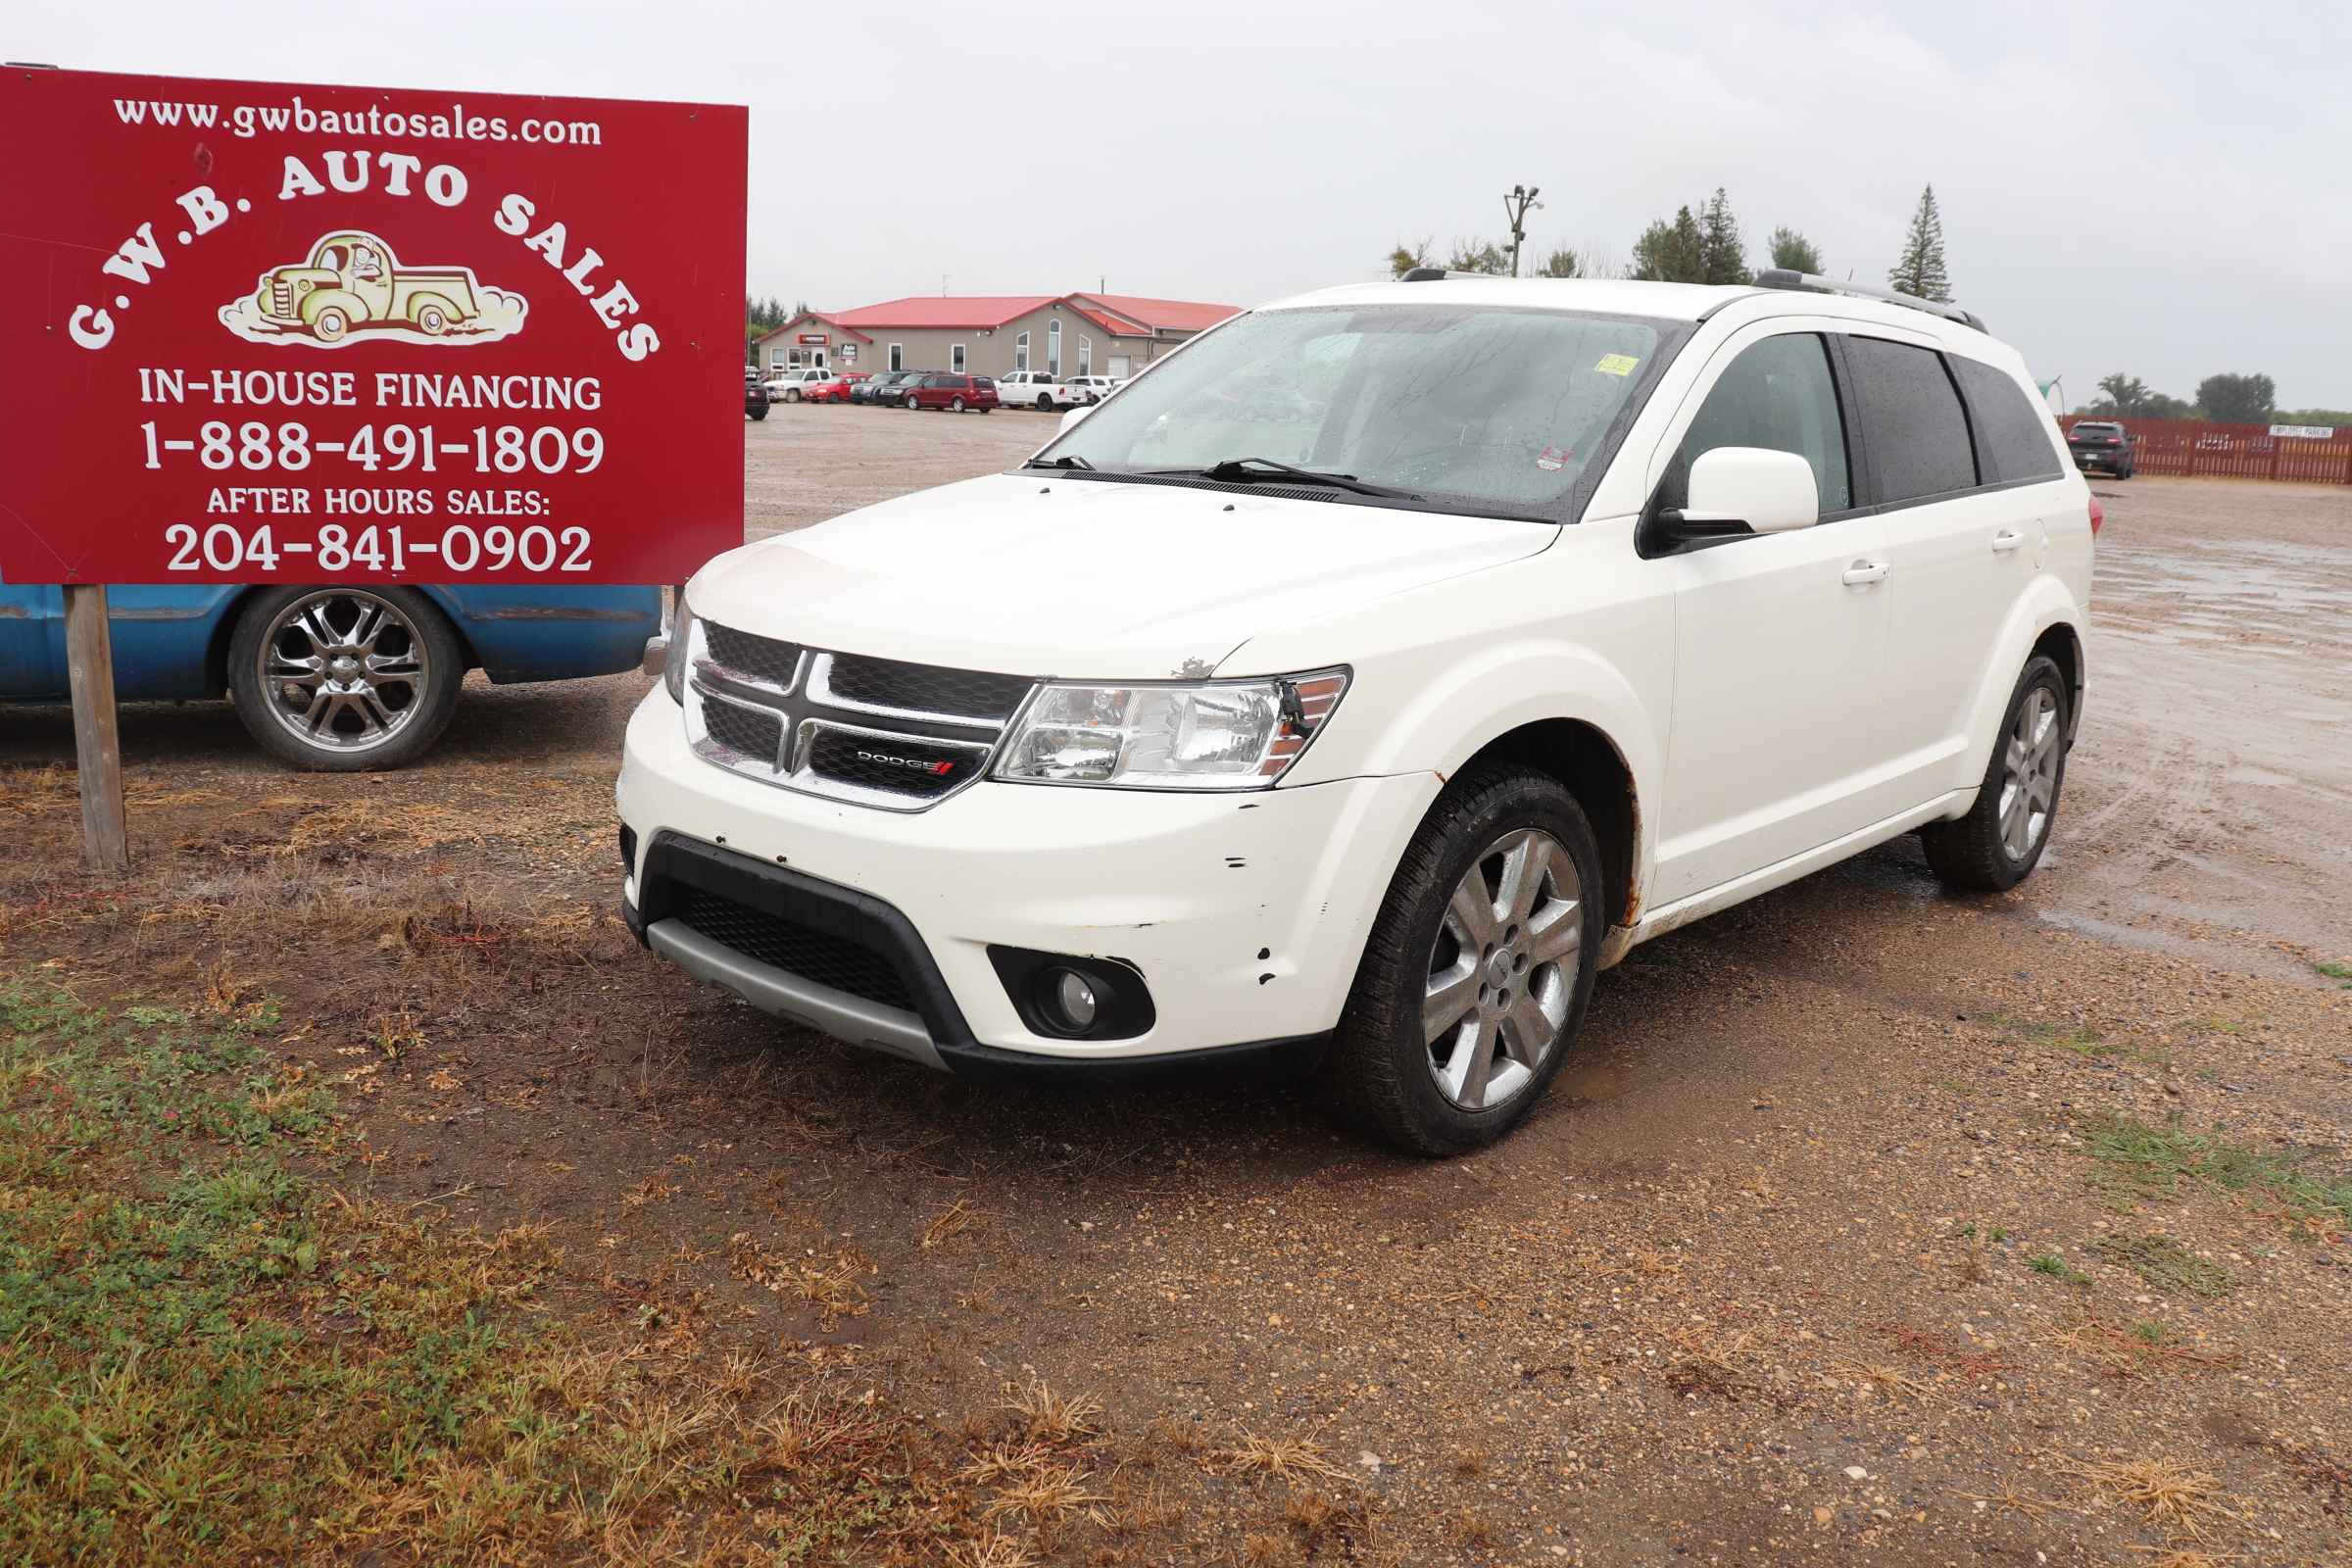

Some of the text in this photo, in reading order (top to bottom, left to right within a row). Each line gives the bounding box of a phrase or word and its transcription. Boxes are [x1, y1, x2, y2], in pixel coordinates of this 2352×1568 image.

[114, 95, 602, 146] www.gwbautosales.com
[278, 150, 469, 207] AUTO
[494, 193, 661, 362] SALES
[139, 368, 602, 411] IN-HOUSE FINANCING
[140, 420, 605, 474] 1-888-491-1809
[2274, 425, 2331, 437] EMPLOYEE PARKING
[207, 487, 551, 516] AFTER HOURS SALES:
[166, 522, 592, 572] 204-841-0902
[858, 751, 939, 770] DODGE
